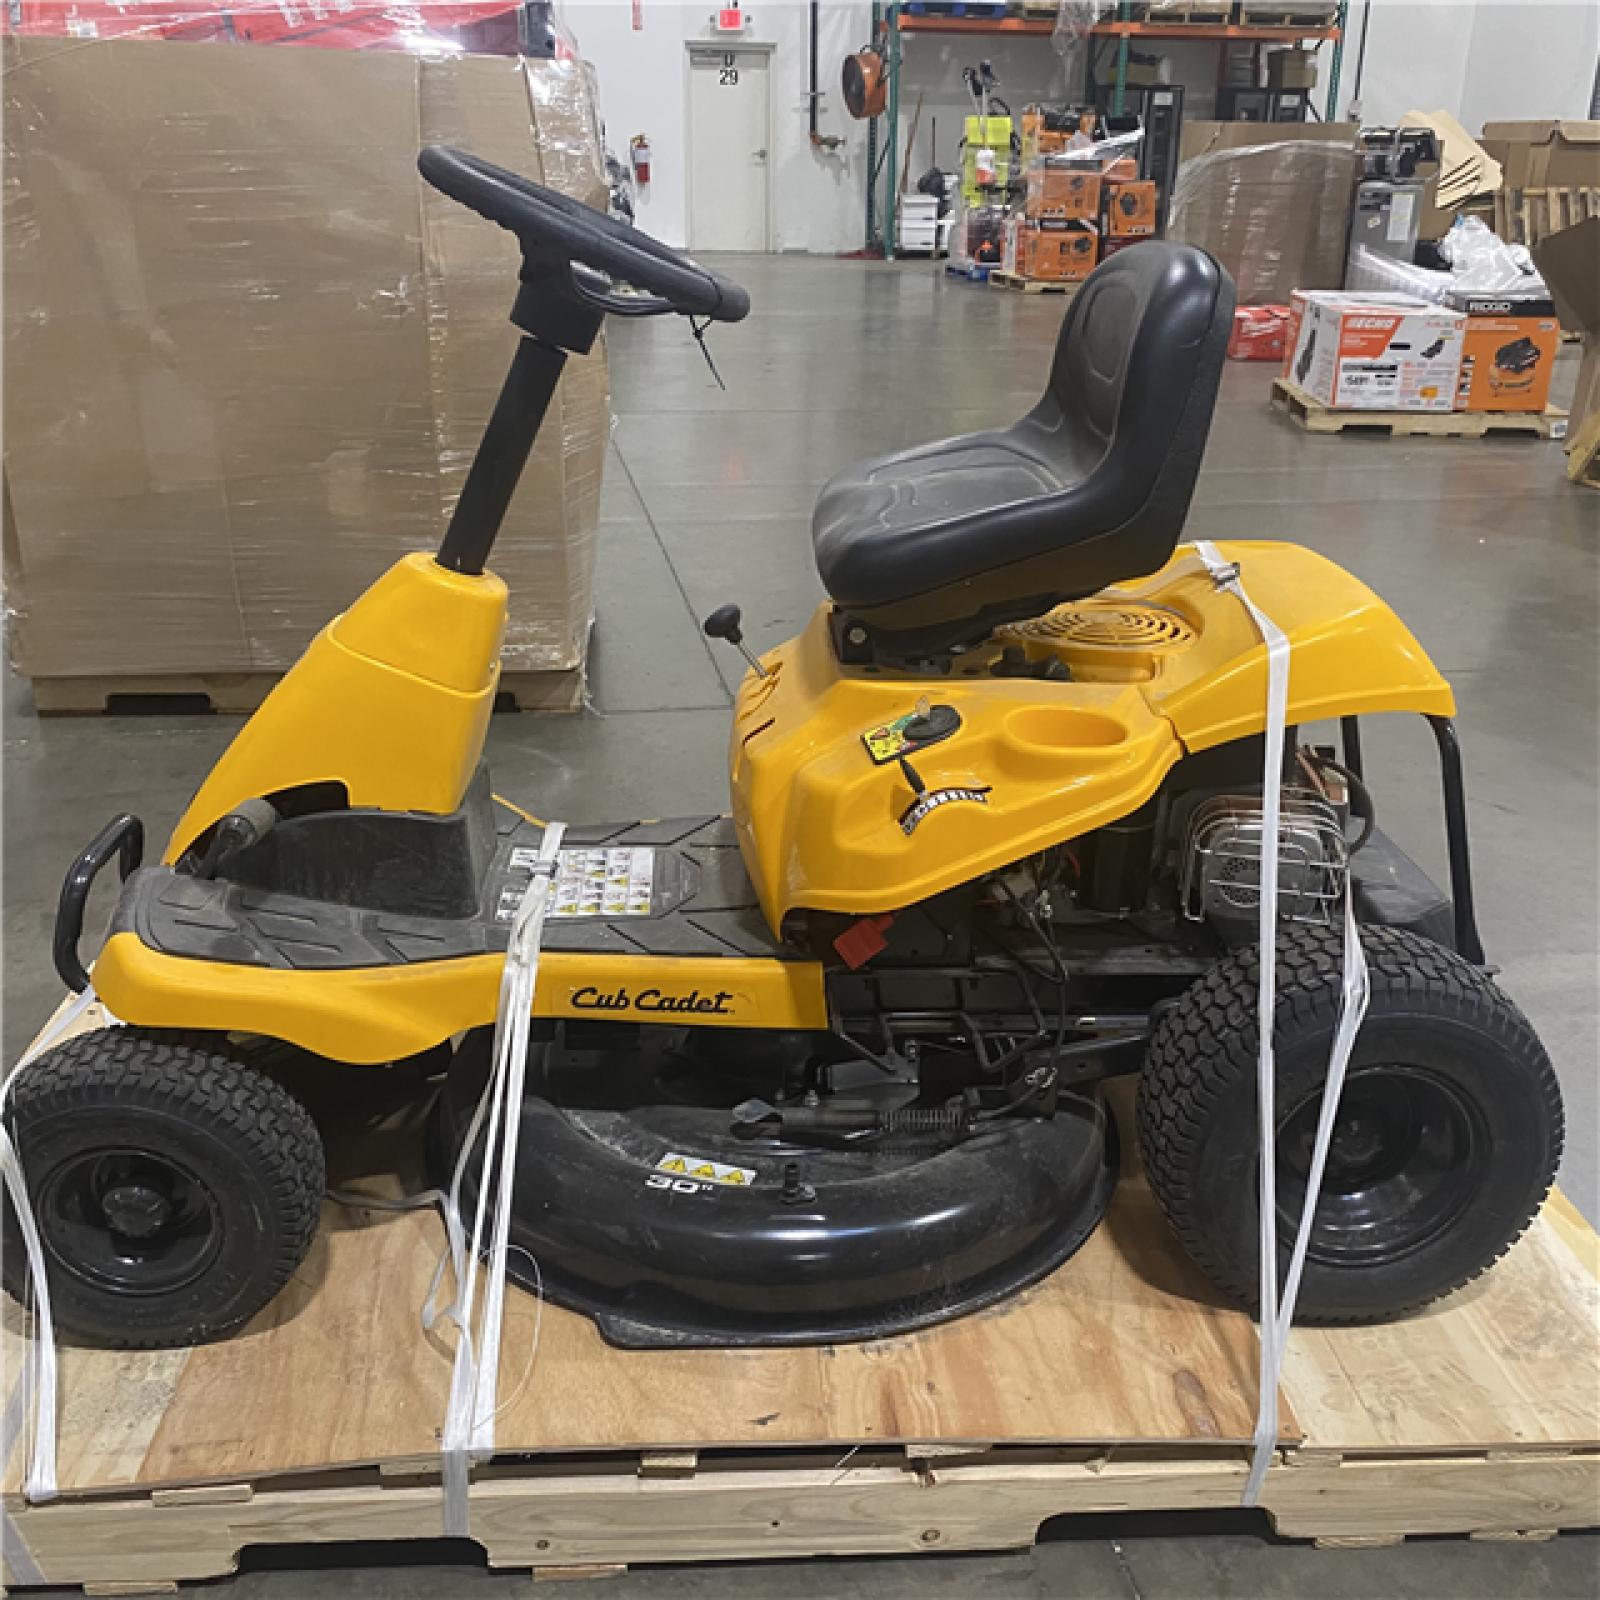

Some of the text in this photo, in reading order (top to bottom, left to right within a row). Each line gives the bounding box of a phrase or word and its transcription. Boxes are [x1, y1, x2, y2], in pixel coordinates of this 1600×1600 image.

[719, 70, 738, 86] 29
[571, 986, 734, 1014] Cub Cadet
